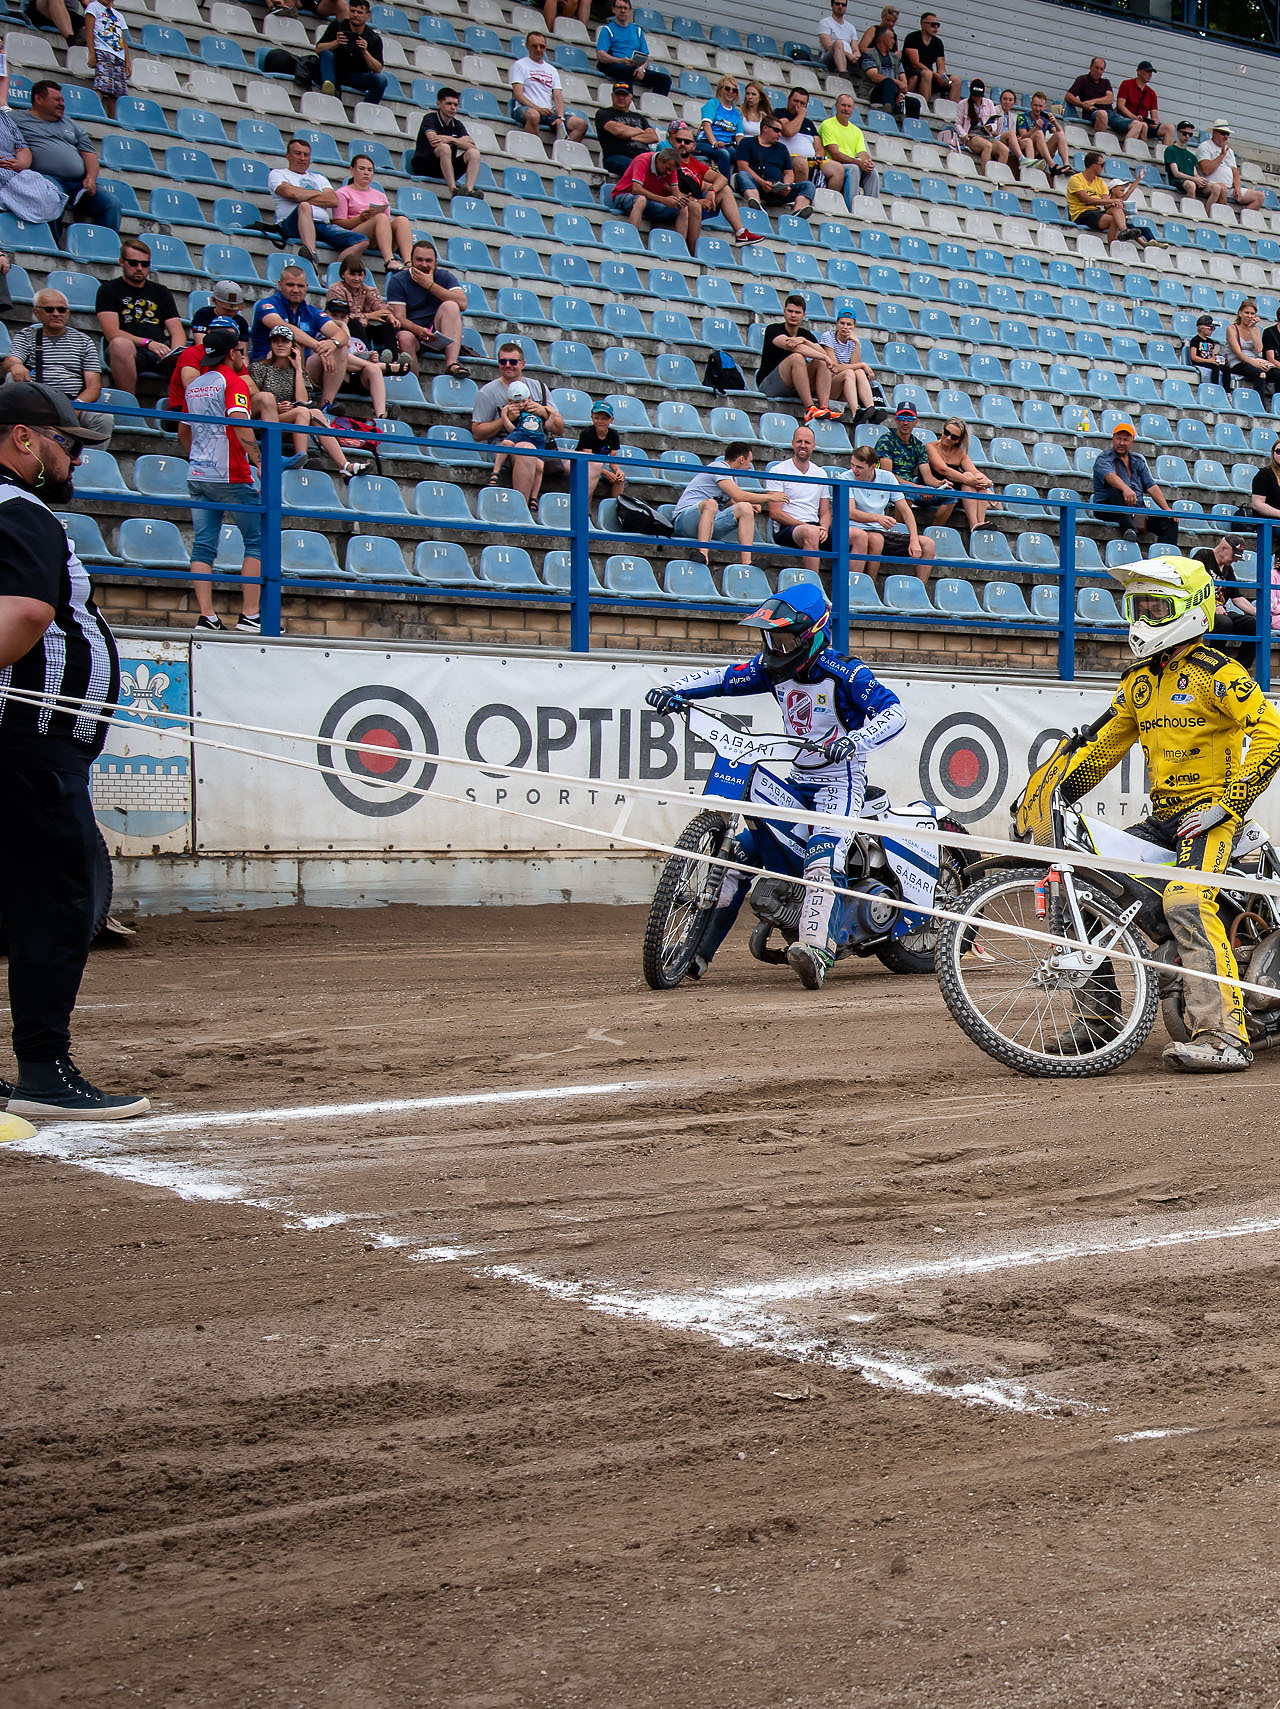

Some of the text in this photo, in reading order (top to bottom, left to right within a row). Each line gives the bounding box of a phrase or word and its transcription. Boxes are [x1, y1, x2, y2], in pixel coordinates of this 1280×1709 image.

[820, 655, 849, 675] SAGARI
[710, 730, 774, 757] SAGARI
[713, 772, 745, 785] SAGARI
[760, 777, 794, 808] SAGARI
[1179, 838, 1194, 865] CAR
[895, 864, 934, 894] SAGARI
